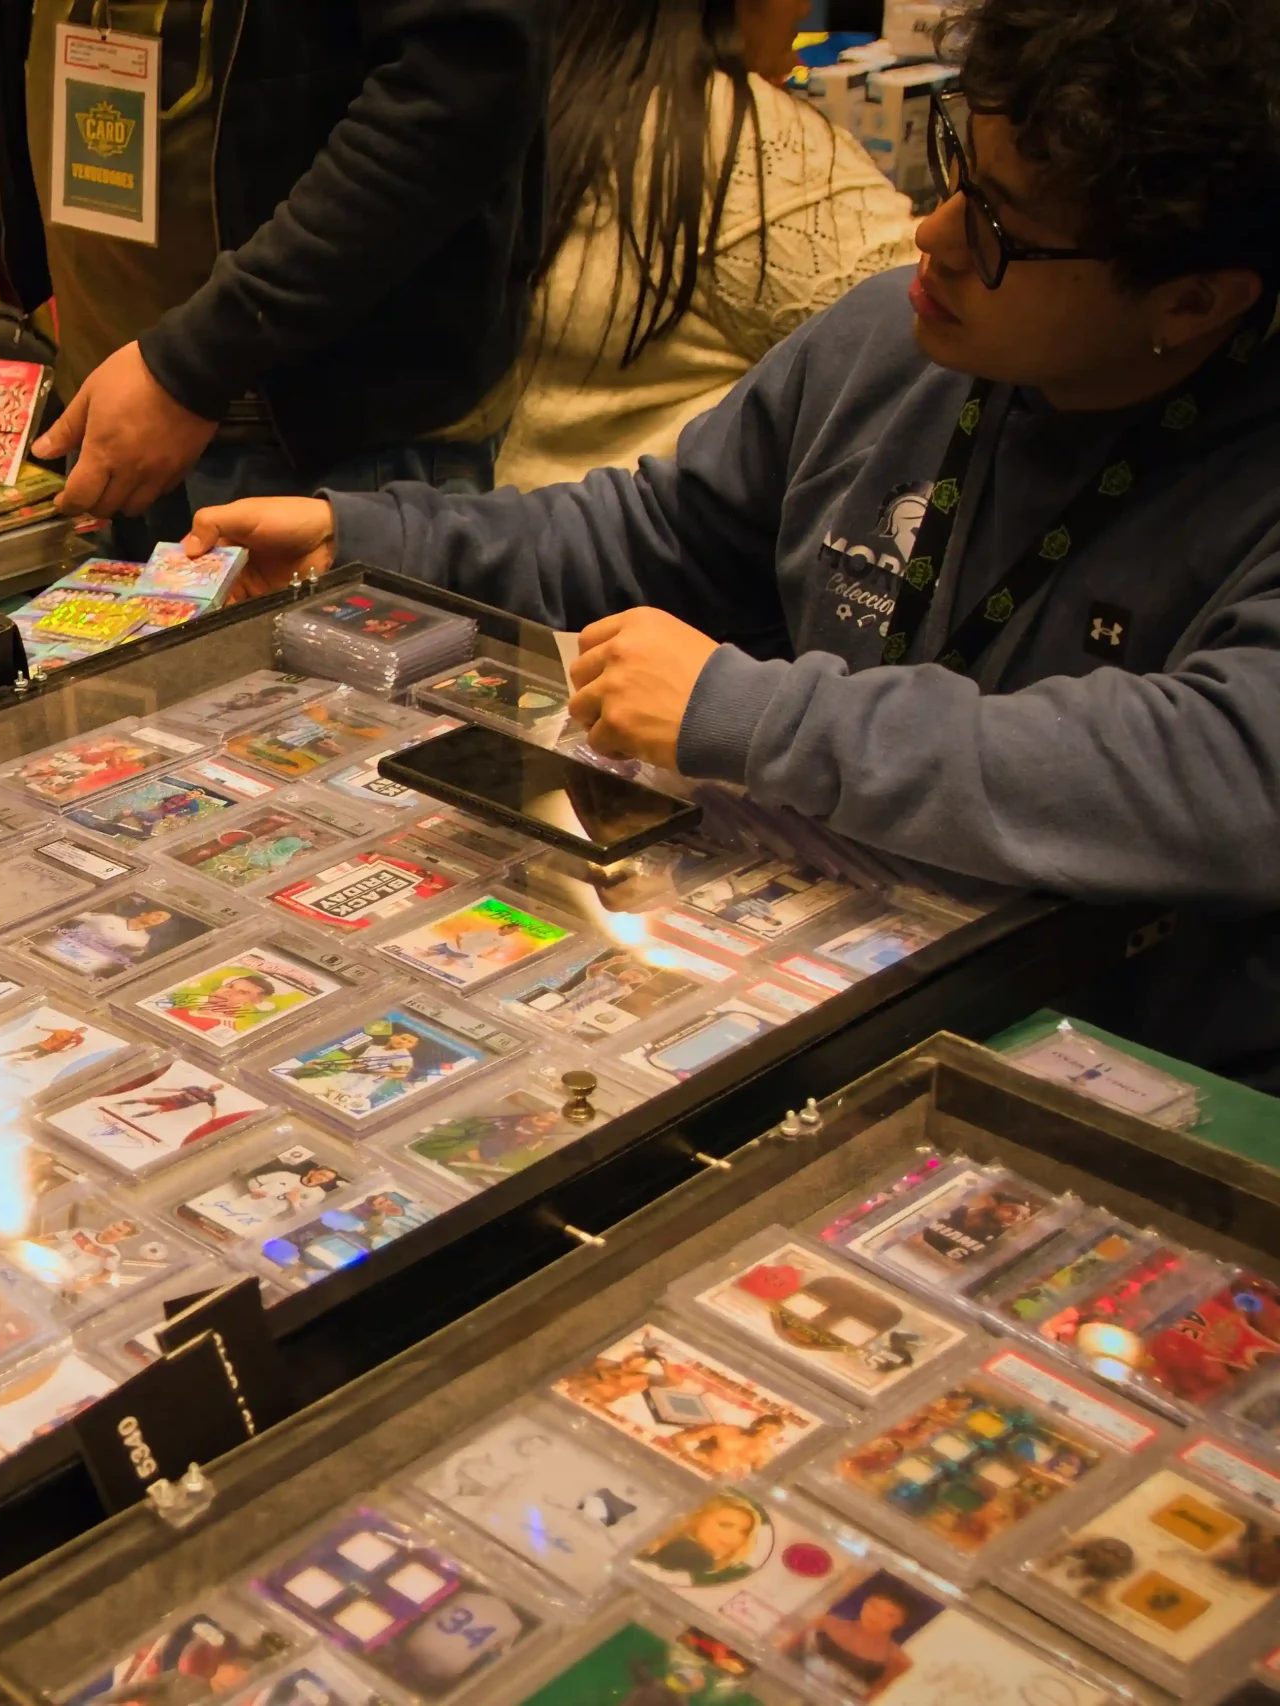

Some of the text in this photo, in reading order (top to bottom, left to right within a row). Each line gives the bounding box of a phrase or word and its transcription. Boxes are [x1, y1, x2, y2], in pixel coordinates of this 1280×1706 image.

[86, 118, 125, 143] CARD
[319, 870, 393, 911] FRIDAY
[339, 877, 410, 917] BLACK
[435, 1607, 497, 1651] 34
